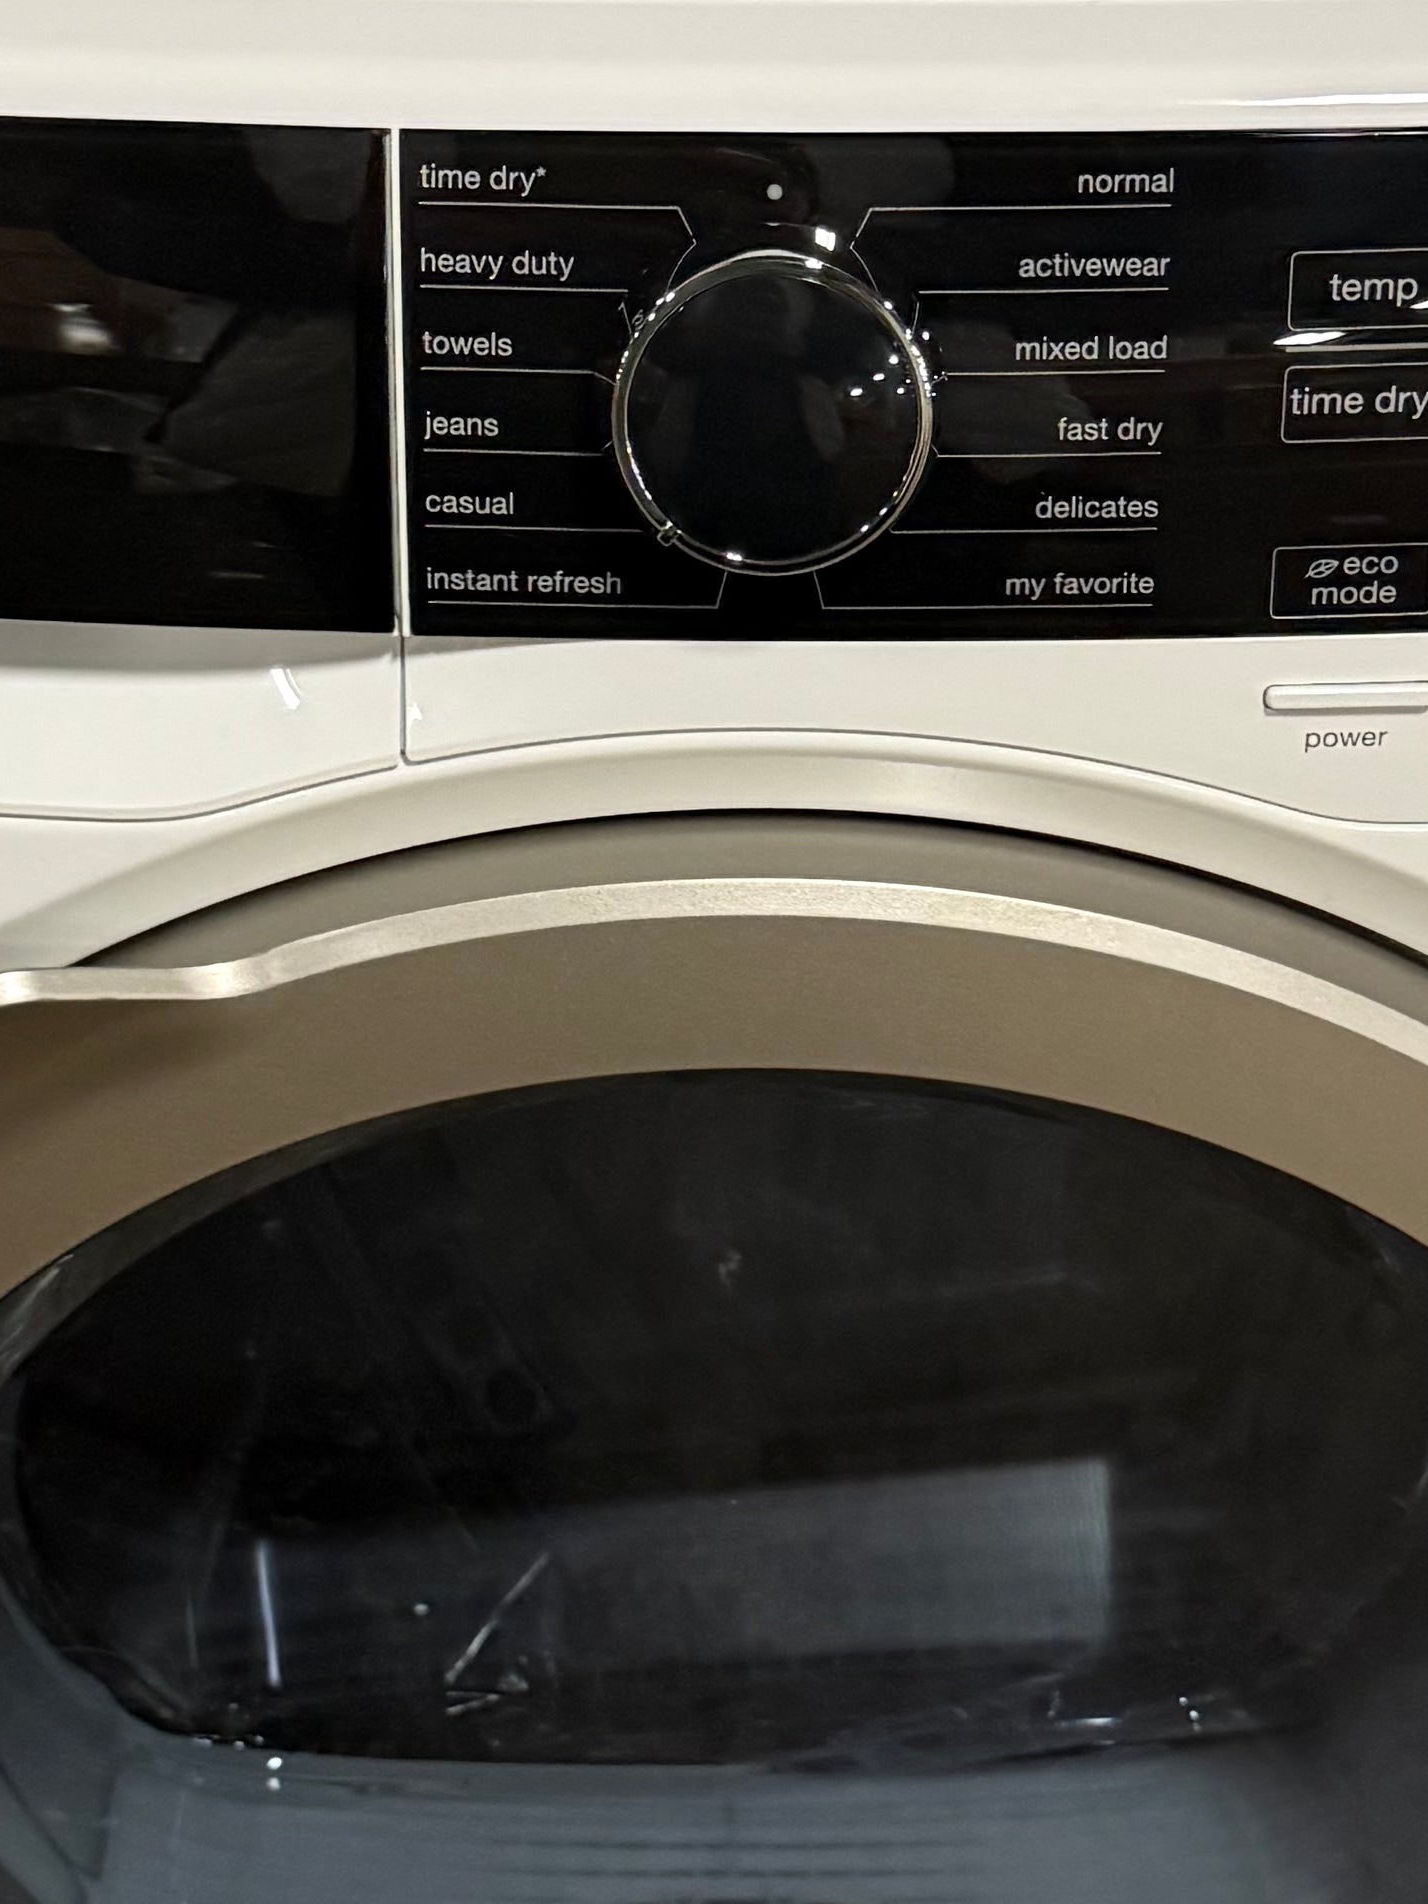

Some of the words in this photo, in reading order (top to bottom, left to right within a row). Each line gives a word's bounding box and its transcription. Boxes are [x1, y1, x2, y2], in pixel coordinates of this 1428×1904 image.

[419, 163, 481, 190] time
[1077, 167, 1175, 194] normal
[420, 247, 503, 280] heavy
[512, 249, 575, 281] duty
[1018, 252, 1172, 279] activewear
[1329, 272, 1419, 307] temp
[422, 330, 513, 357] towels
[1014, 336, 1099, 361] mixed
[1108, 334, 1168, 360] load
[1290, 386, 1364, 416] time
[424, 411, 499, 441] jeans
[1057, 416, 1109, 441] fast
[1117, 416, 1163, 447] dry
[425, 492, 515, 516] casual
[1035, 496, 1160, 519] delicates
[1343, 553, 1399, 576] eco
[426, 567, 519, 593] instant
[527, 571, 623, 595] refresh
[1005, 575, 1045, 600] my
[1053, 572, 1154, 595] favorite
[1310, 579, 1397, 606] mode
[1304, 728, 1388, 753] power
